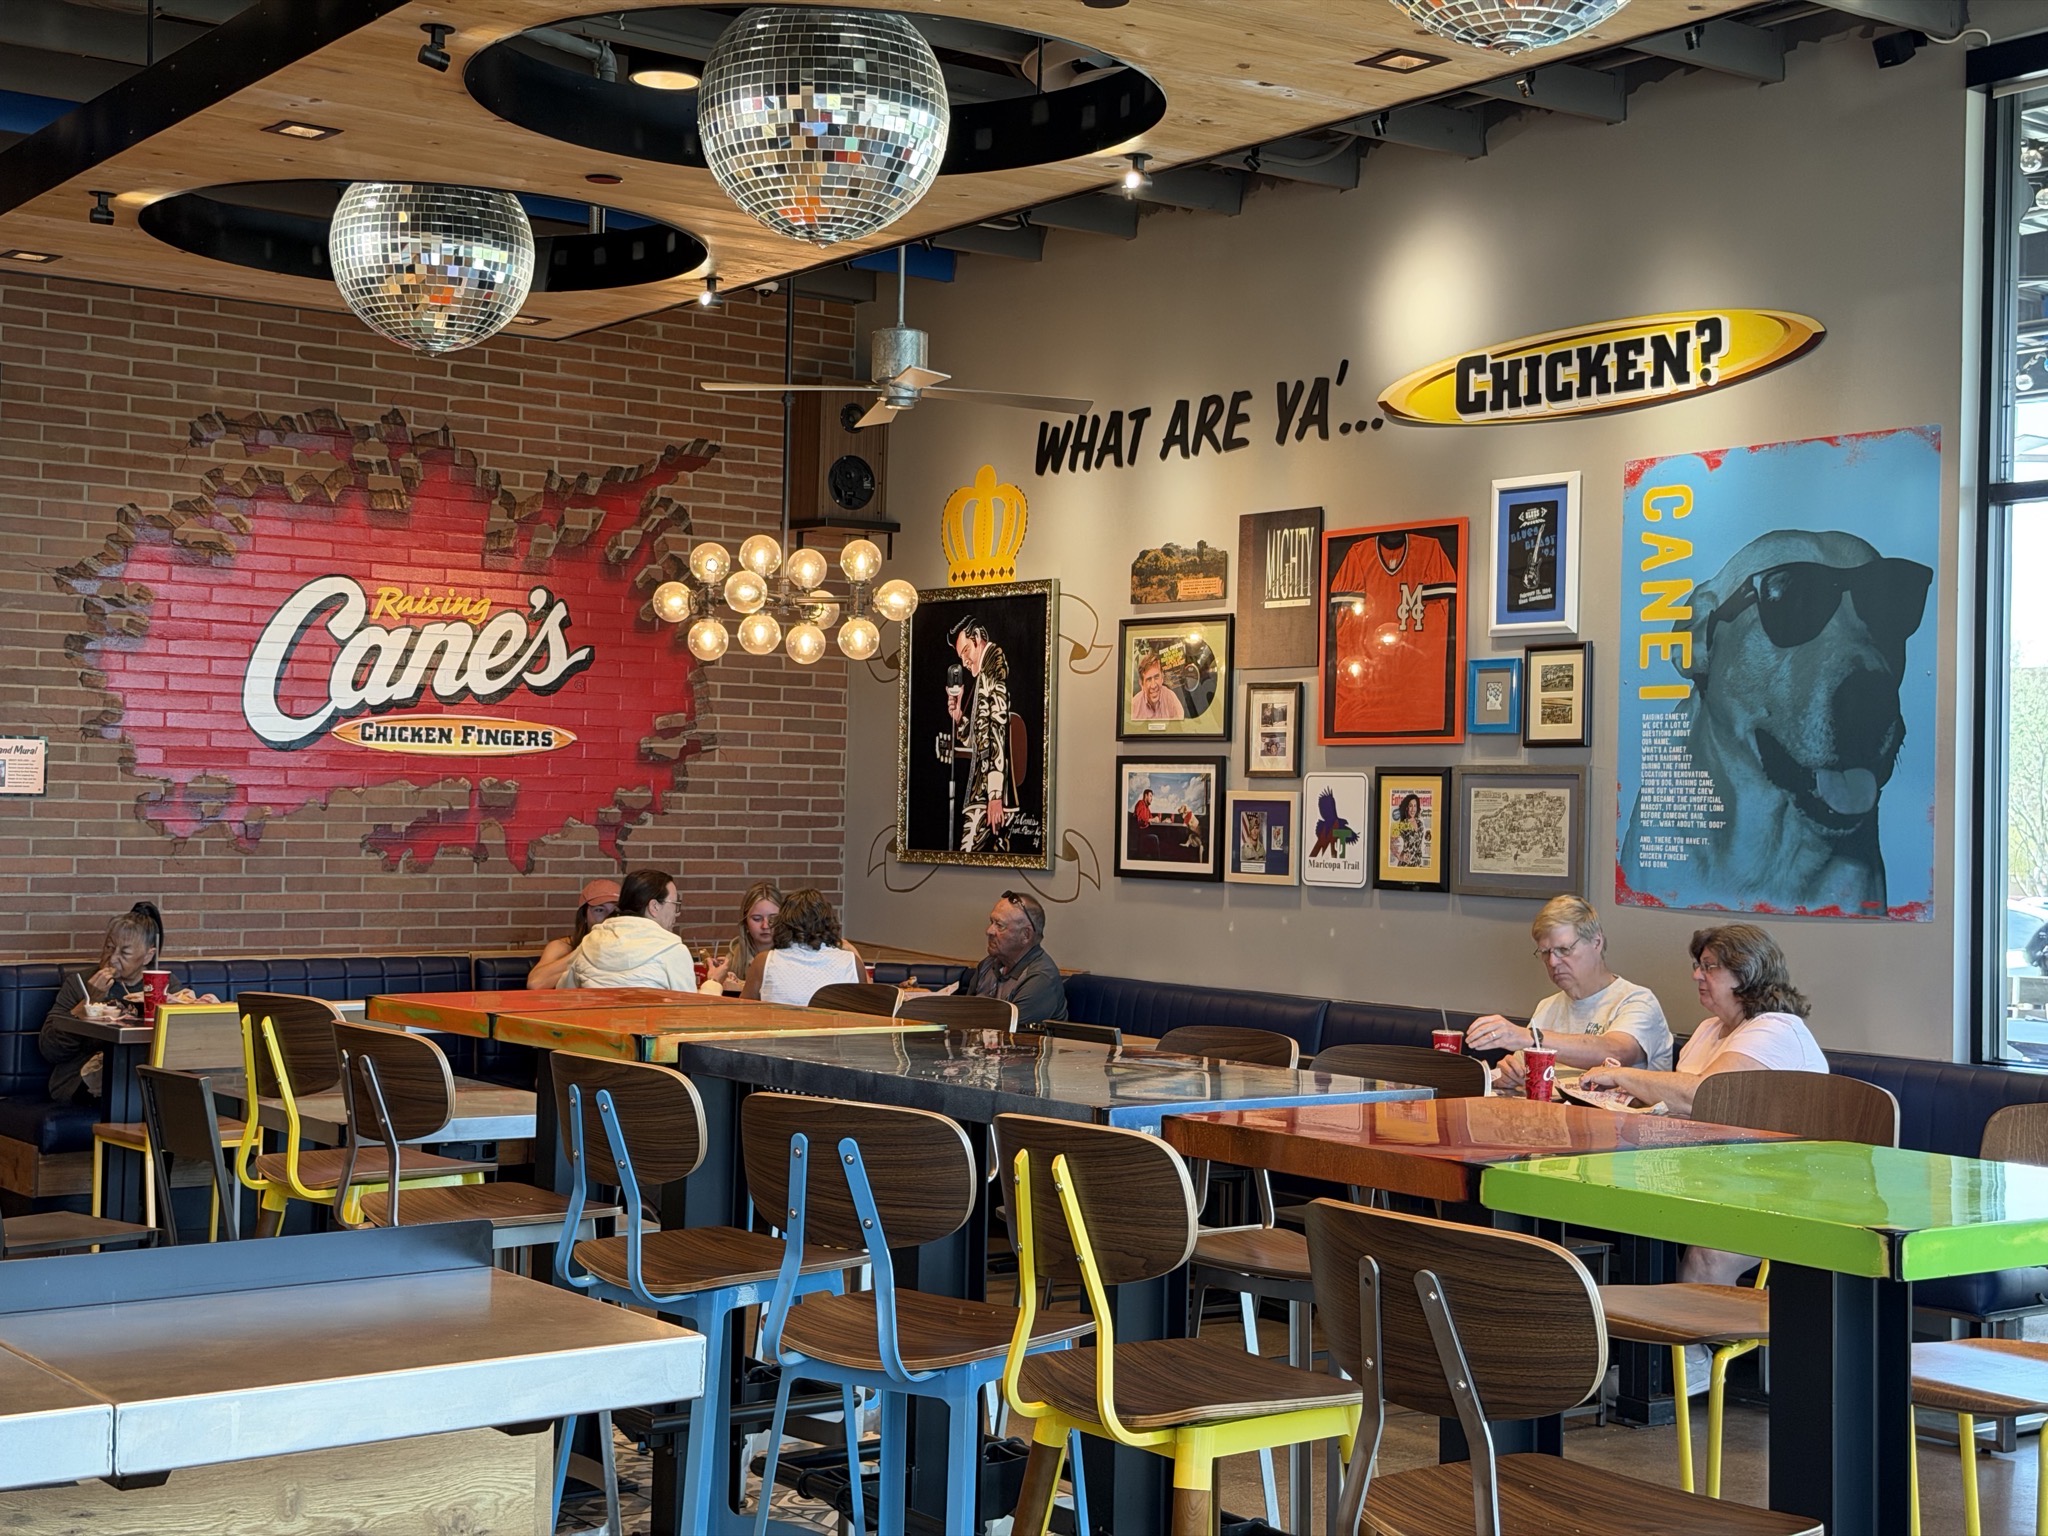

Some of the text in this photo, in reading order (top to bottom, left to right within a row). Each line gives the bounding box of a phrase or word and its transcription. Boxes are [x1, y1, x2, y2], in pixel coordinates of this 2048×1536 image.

[1455, 315, 1729, 423] CHICKEN?
[1034, 408, 1150, 477] WHAT
[1159, 390, 1252, 461] ARE
[1265, 527, 1314, 600] MIGHTY
[1640, 484, 1694, 669] CANE
[371, 586, 491, 626] Raising
[243, 574, 594, 750] Cane's
[360, 721, 554, 748] CHICKEN FINGERS
[1309, 860, 1359, 871] Maricopa Trail
